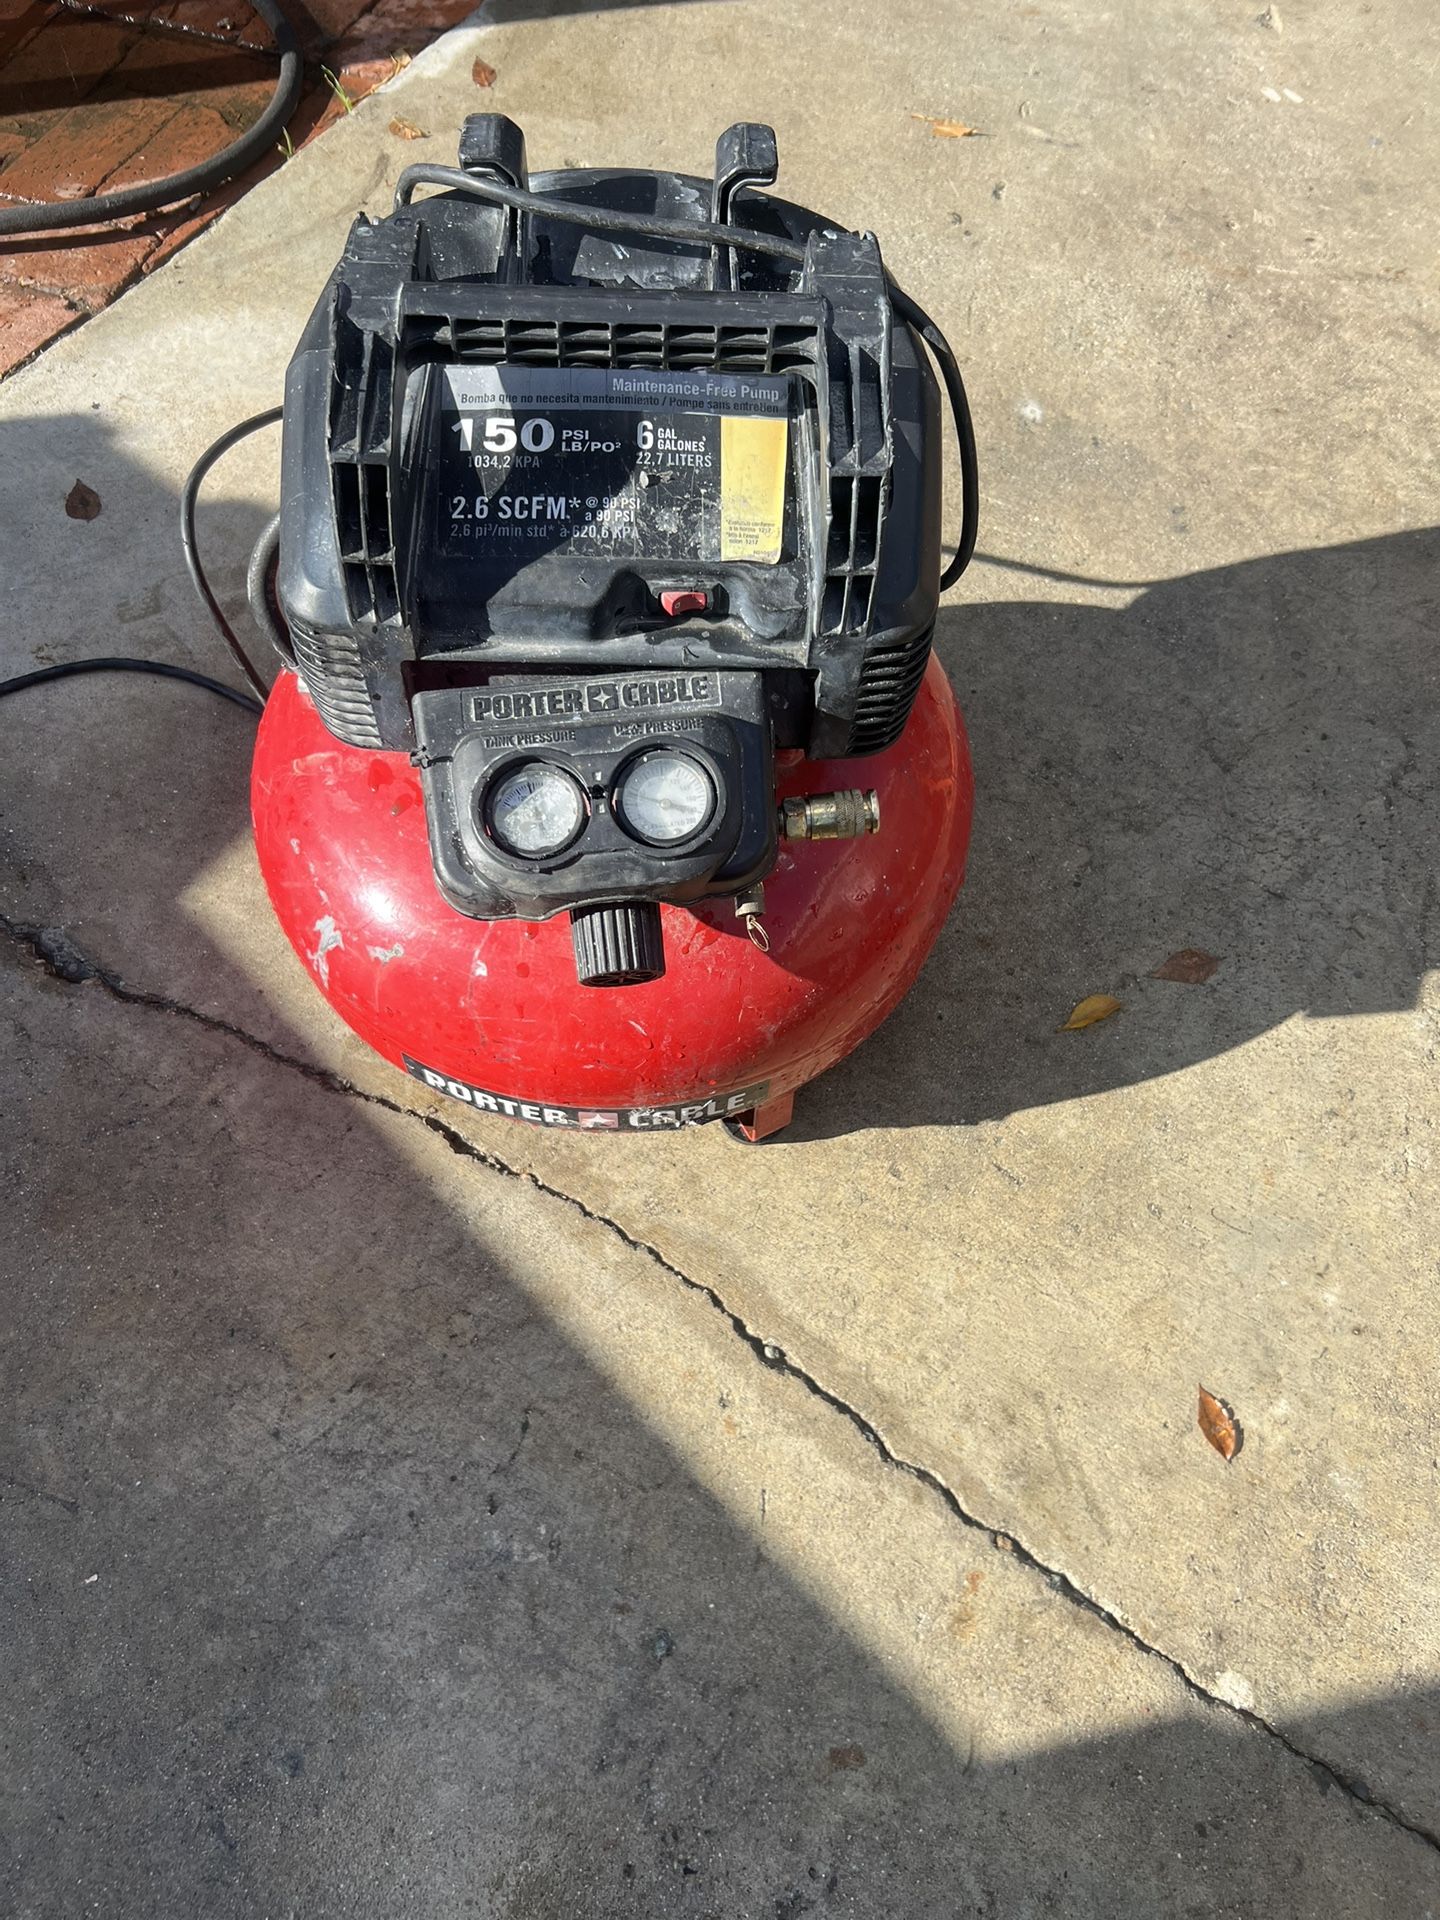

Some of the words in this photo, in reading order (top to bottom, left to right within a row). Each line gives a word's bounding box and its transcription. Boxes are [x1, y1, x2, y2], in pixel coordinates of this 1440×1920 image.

[613, 378, 736, 398] Maintenance-Free
[741, 385, 779, 402] Pump
[461, 393, 495, 404] Bomba
[499, 394, 517, 405] que
[521, 395, 533, 404] no
[536, 393, 579, 404] necesita
[582, 394, 660, 406] mantenimiento
[670, 397, 704, 409] Pompe
[707, 399, 731, 410] sans
[733, 402, 779, 414] entretien
[451, 418, 555, 452] 150
[562, 430, 589, 440] PSI
[637, 420, 654, 450] 6
[658, 428, 677, 440] GAL
[658, 440, 705, 452] GALONES
[468, 455, 511, 468] 1034,2
[515, 456, 540, 468] KPA
[636, 452, 662, 466] 22,7
[669, 454, 712, 467] LITERS
[452, 496, 489, 519] 2.6
[585, 497, 598, 508] @
[602, 497, 616, 509] 90
[621, 498, 640, 509] PSI
[585, 512, 592, 521] a
[596, 510, 610, 521] 90
[615, 510, 634, 522] PSI
[451, 524, 471, 538] 2,6
[613, 525, 639, 538] KPA
[473, 688, 583, 721] PORTER
[621, 676, 708, 708] CABLE
[644, 718, 704, 734] PRESSURE
[484, 734, 516, 748] TANK
[517, 730, 576, 745] PRESSURE
[422, 1068, 569, 1124] PORTER
